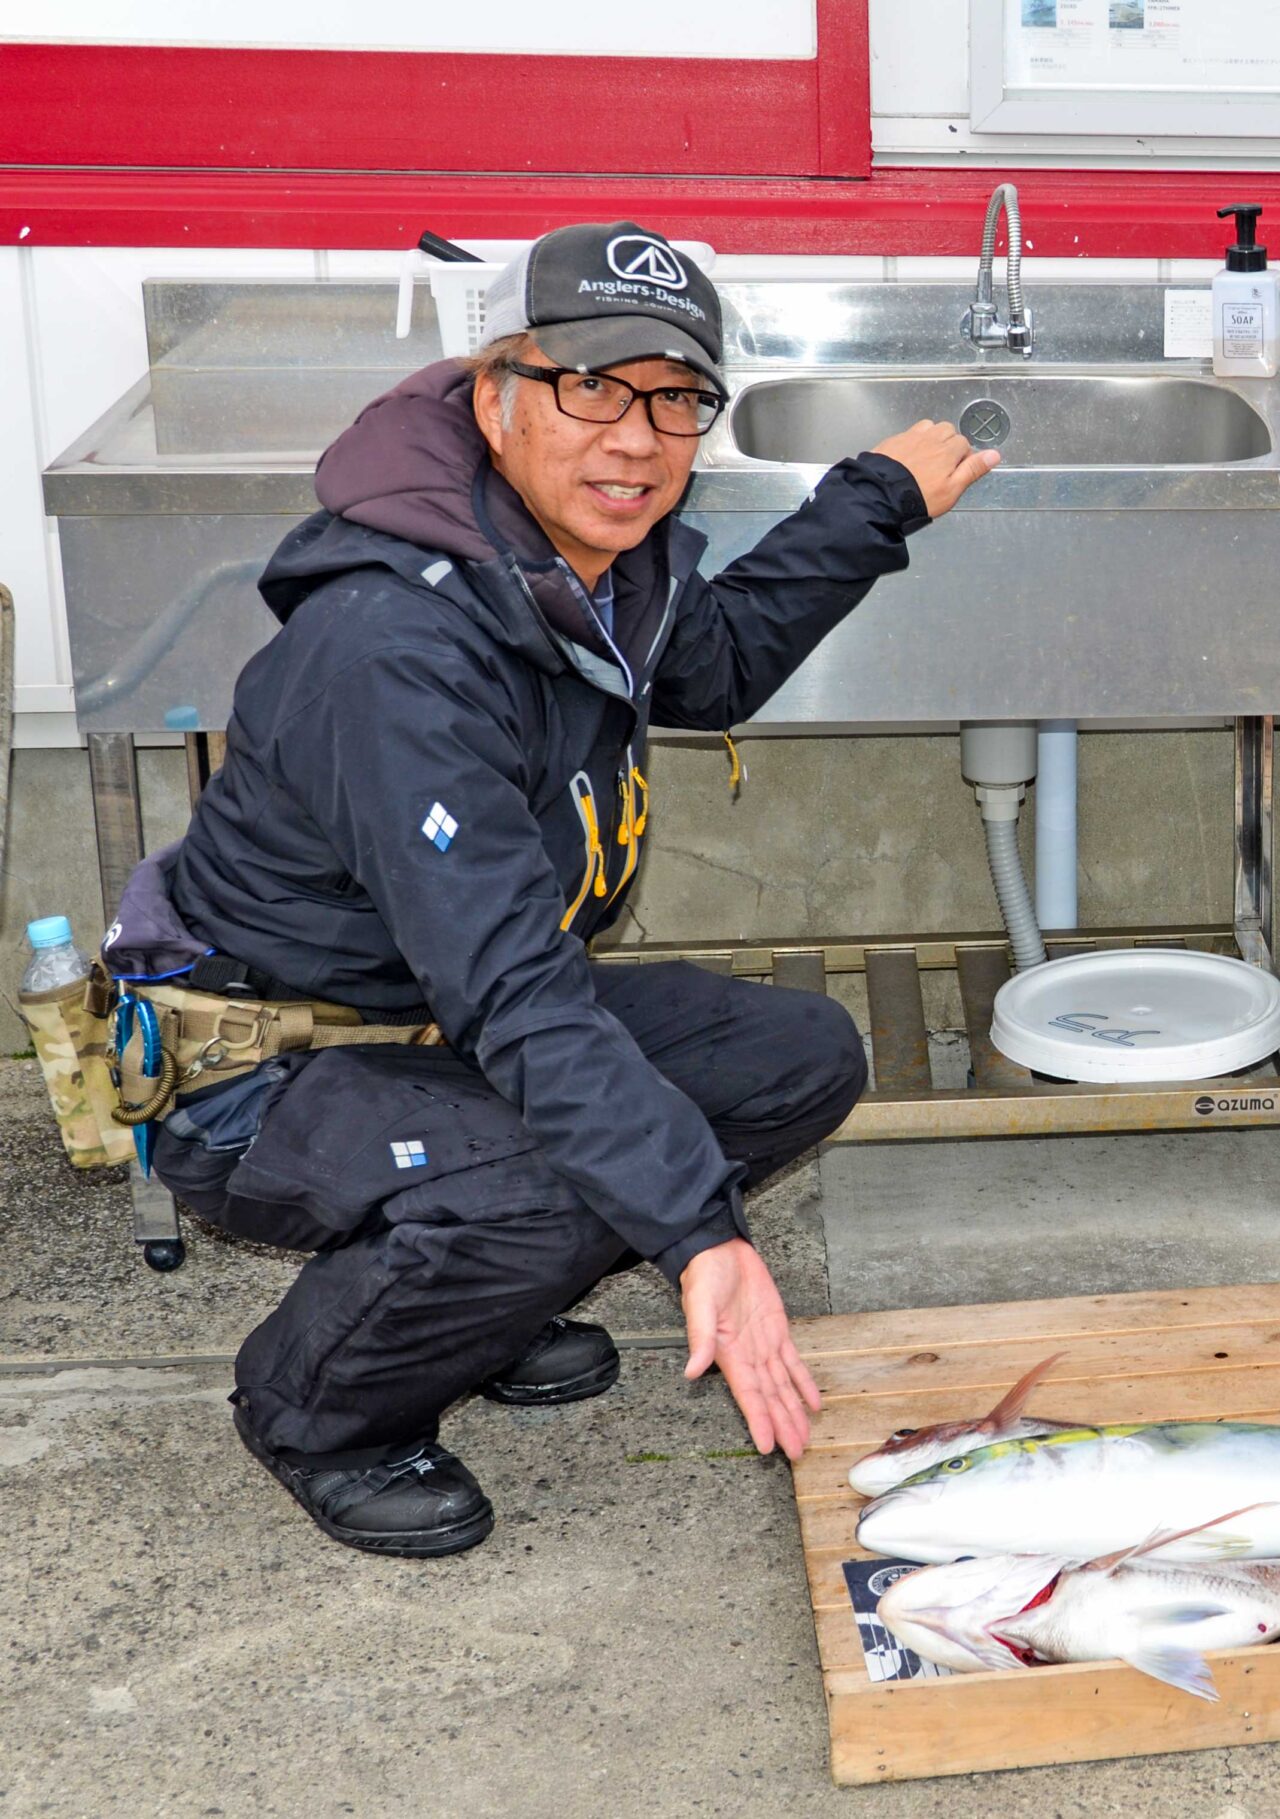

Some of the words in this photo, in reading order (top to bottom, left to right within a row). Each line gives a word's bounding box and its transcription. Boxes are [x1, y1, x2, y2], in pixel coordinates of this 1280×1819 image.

[578, 279, 706, 321] Anglers-Design
[1231, 314, 1254, 325] SOAP
[1217, 1098, 1275, 1111] azuma
